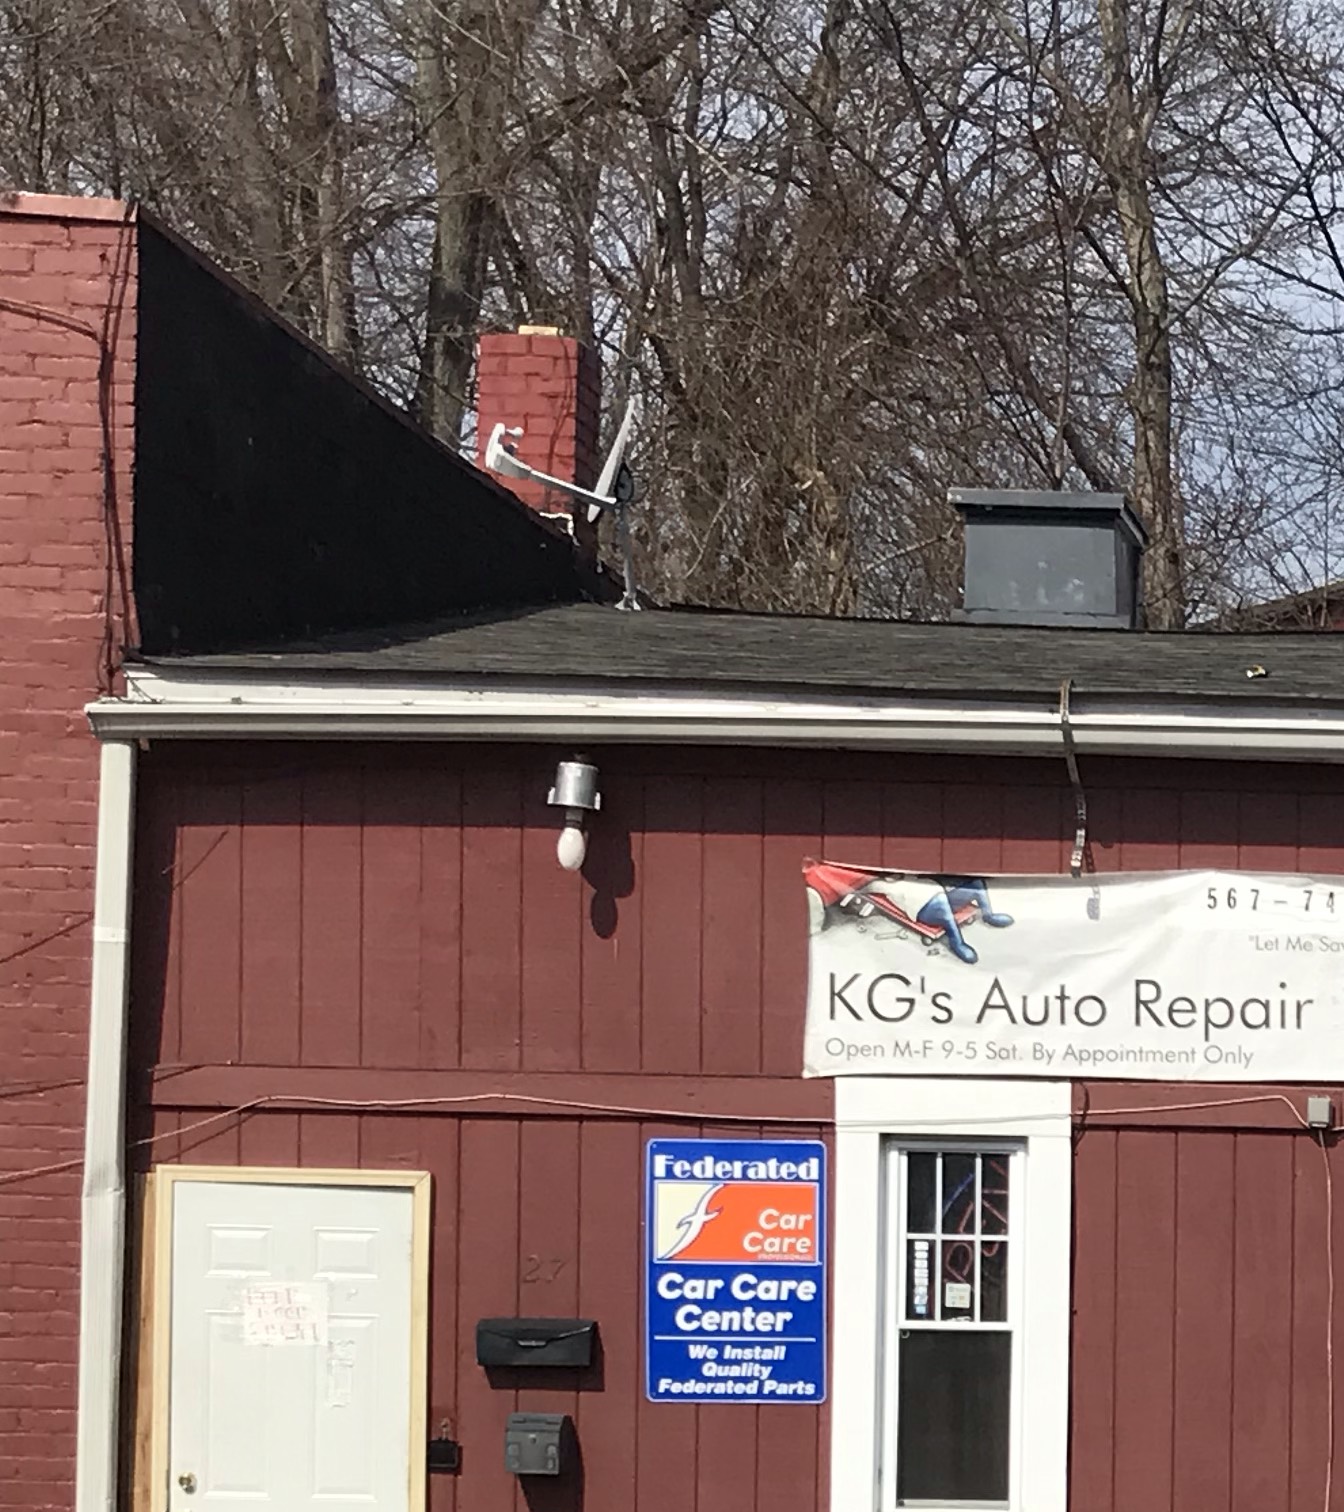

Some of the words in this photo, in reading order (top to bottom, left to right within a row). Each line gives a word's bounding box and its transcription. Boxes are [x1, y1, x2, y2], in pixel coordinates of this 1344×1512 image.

[1287, 937, 1314, 952] Me
[829, 972, 954, 1024] KG's
[975, 976, 1107, 1026] Auto
[1134, 979, 1314, 1042] Repair
[825, 1037, 885, 1060] Open
[892, 1040, 934, 1058] M-F
[941, 1040, 978, 1060] 9-5
[985, 1041, 1023, 1061] Sat.
[1032, 1043, 1056, 1065] By
[1062, 1043, 1196, 1067] Appointment
[1203, 1044, 1254, 1069] Only
[654, 1154, 819, 1180] Federated
[758, 1208, 813, 1230] Car
[742, 1231, 812, 1253] Care
[657, 1272, 725, 1300] Car
[731, 1273, 817, 1301] Care
[674, 1304, 794, 1332] Center
[688, 1344, 718, 1360] We
[723, 1344, 787, 1361] Install
[701, 1361, 774, 1380] Quality
[658, 1378, 760, 1395] Federated
[763, 1380, 816, 1395] Parts
